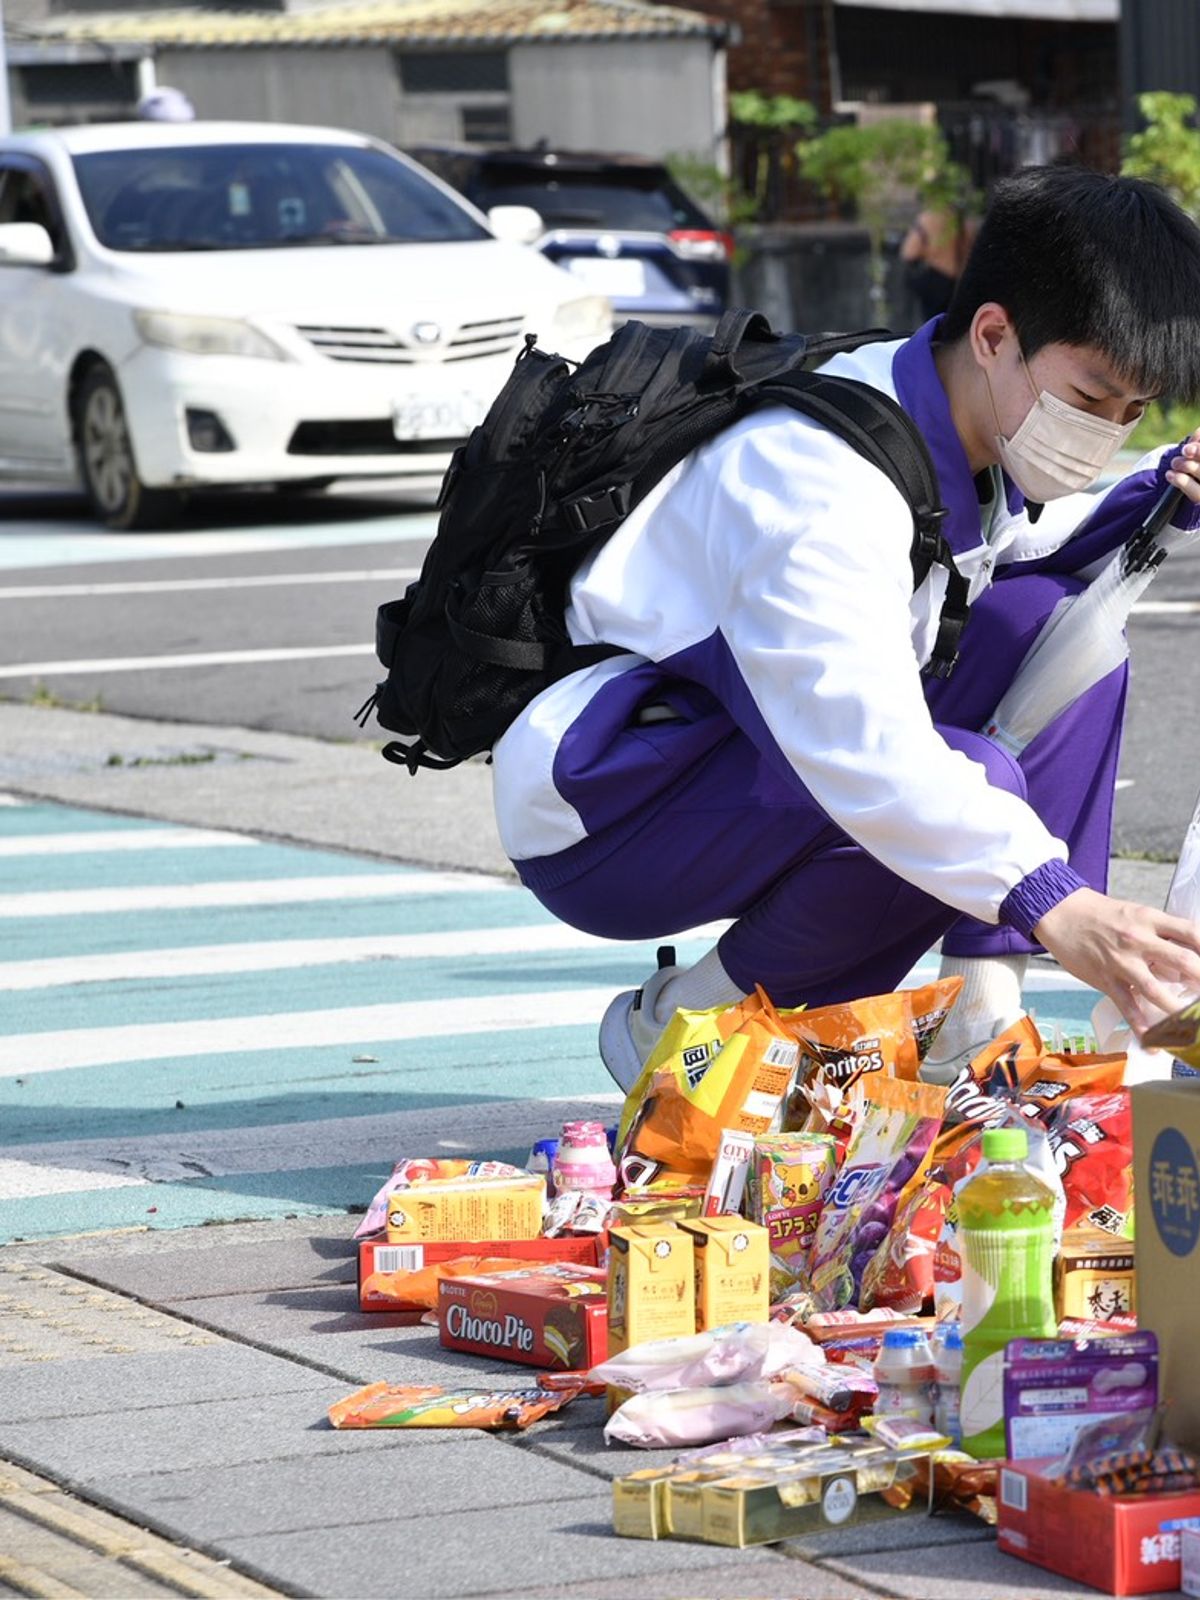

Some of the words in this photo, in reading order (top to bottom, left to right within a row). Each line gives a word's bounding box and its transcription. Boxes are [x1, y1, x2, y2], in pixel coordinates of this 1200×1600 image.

[823, 1051, 883, 1079] oritos
[723, 1144, 751, 1160] CITY
[1152, 1160, 1200, 1223] 乖乖
[446, 1303, 502, 1346] Choco
[502, 1314, 534, 1352] Pie
